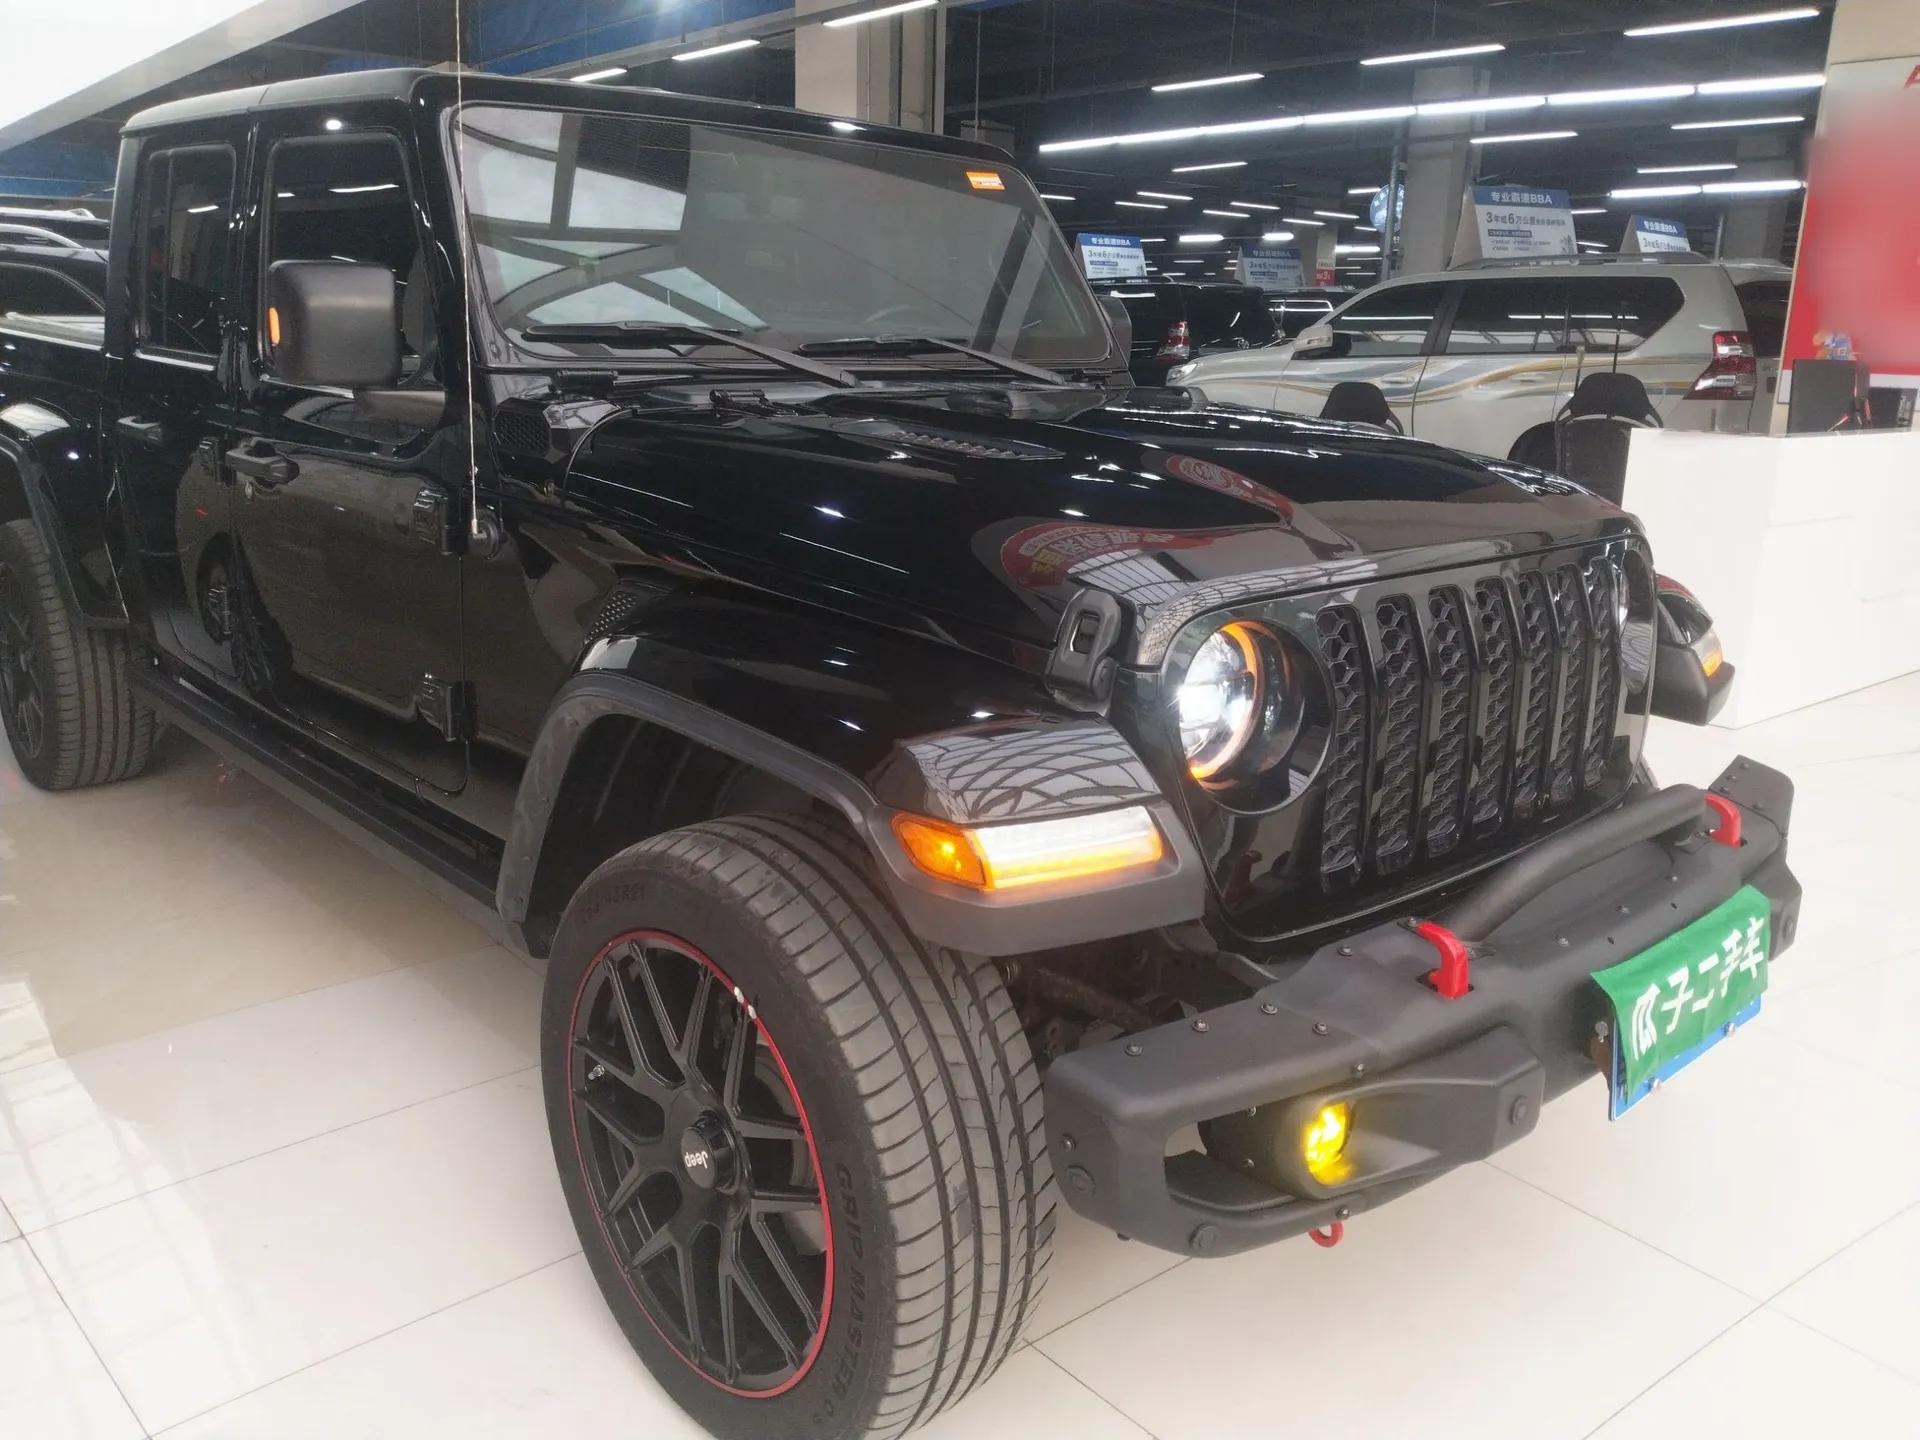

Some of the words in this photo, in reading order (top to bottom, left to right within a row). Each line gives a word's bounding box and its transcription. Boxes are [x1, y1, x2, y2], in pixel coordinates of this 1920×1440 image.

[1631, 916, 1765, 1061] 瓜子二手车
[684, 1150, 709, 1169] Jeep
[836, 1161, 864, 1260] GRIP
